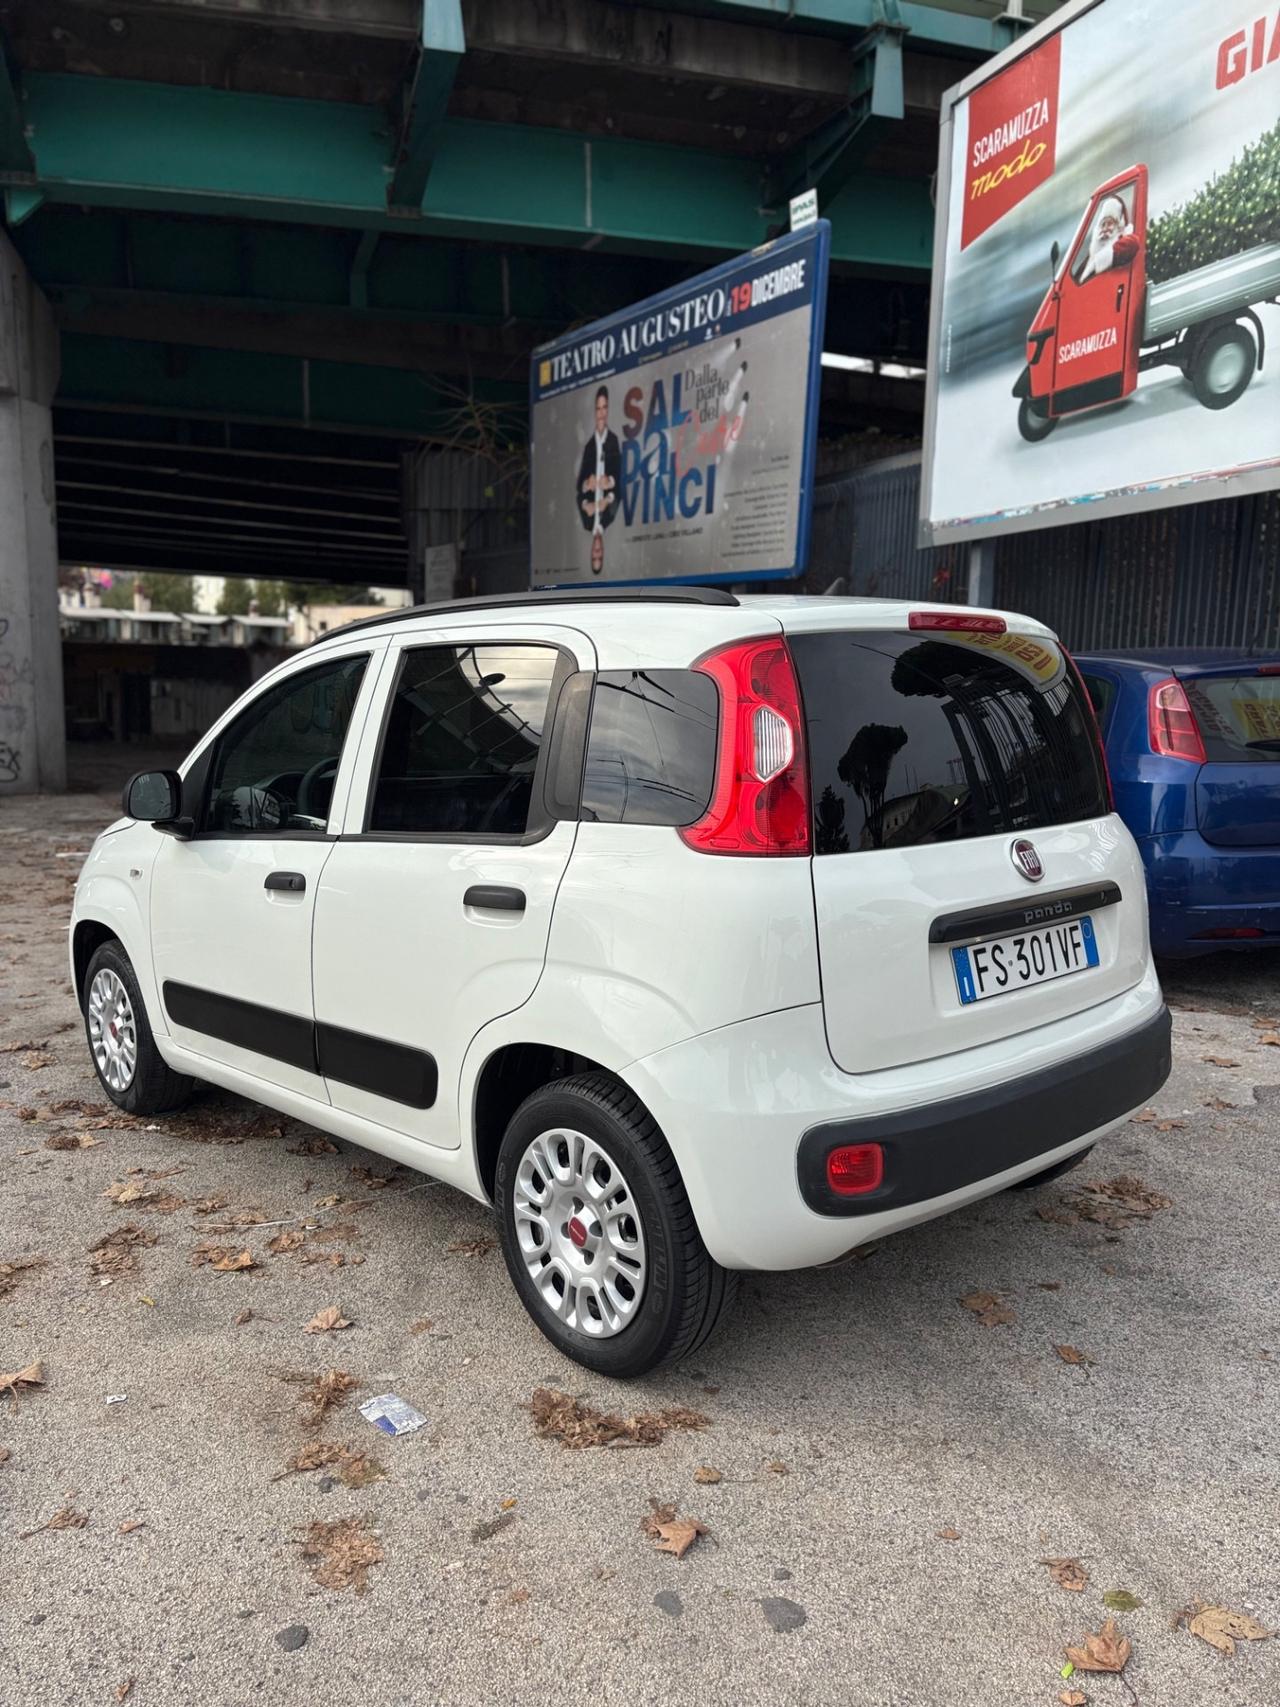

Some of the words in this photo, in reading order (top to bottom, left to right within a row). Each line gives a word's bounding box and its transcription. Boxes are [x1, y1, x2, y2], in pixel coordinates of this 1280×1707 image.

[973, 97, 1049, 168] SCARAMUZZA
[971, 139, 1047, 200] modo
[551, 336, 616, 382] TEATRO
[616, 287, 725, 358] AUGUSTEO
[731, 281, 752, 315] 19
[751, 258, 807, 307] DICEMBRE
[1058, 327, 1118, 364] SCARAMUZZA
[622, 372, 693, 440] SAL
[685, 364, 718, 392] Dalla
[699, 397, 720, 424] del
[622, 464, 717, 527] VINCI
[1023, 900, 1073, 924] panda
